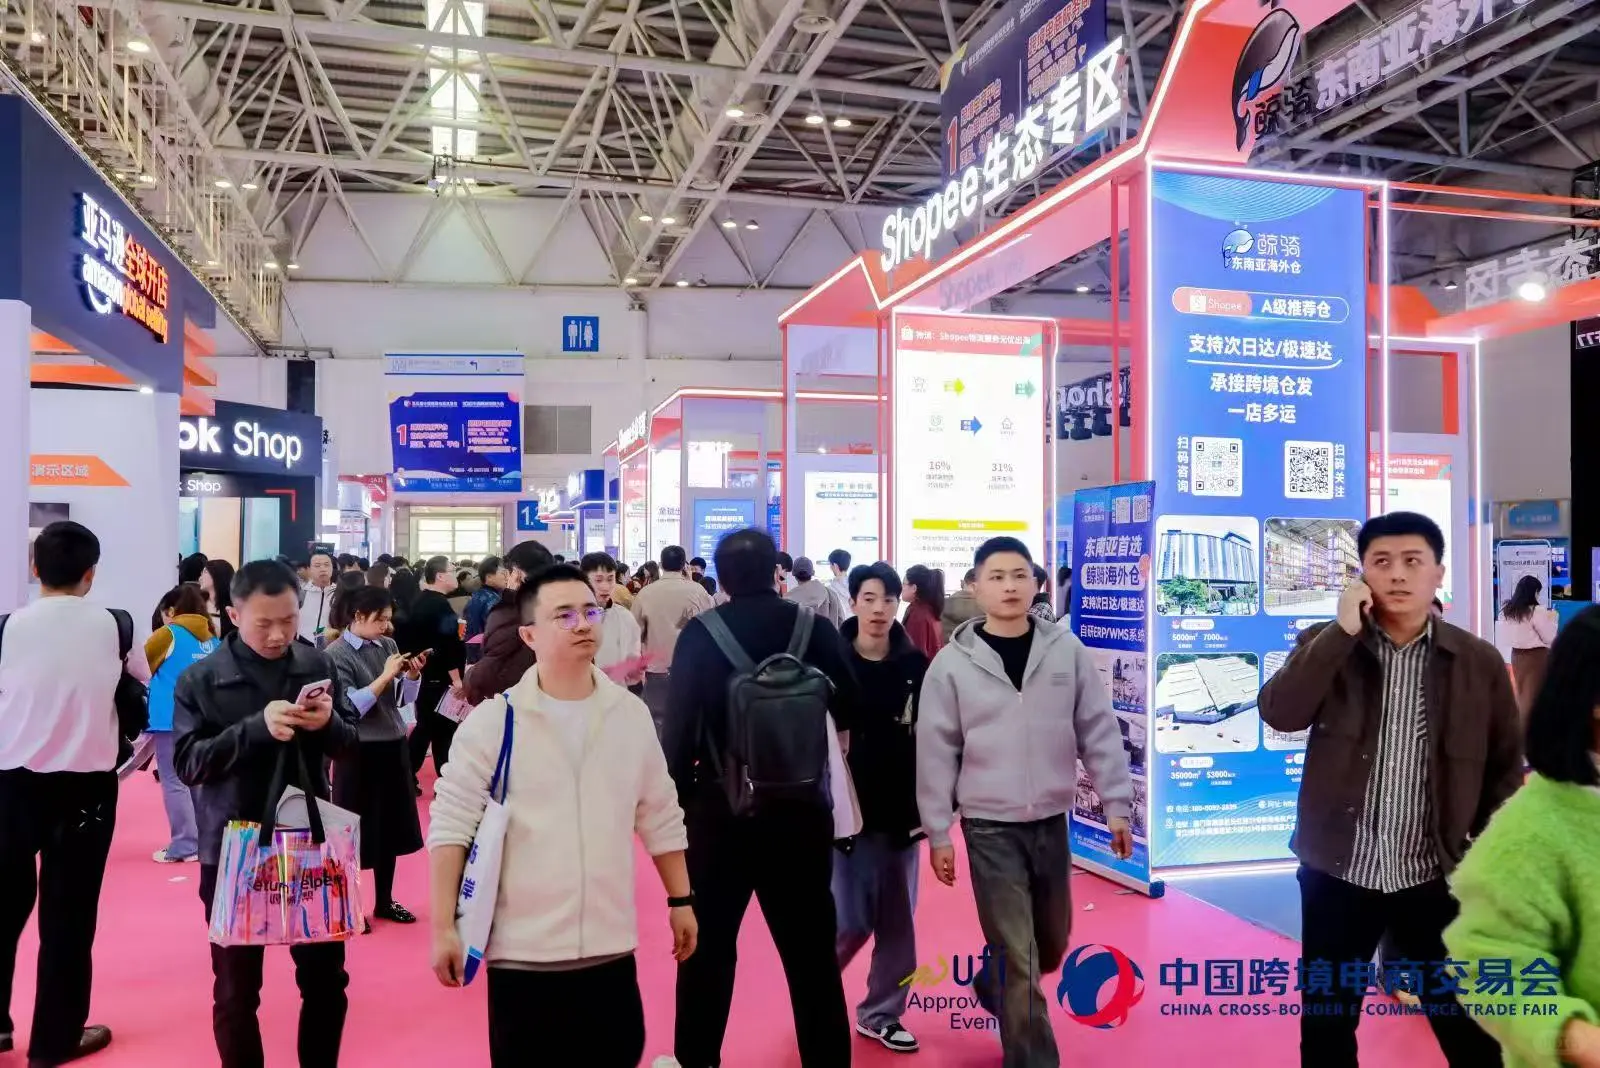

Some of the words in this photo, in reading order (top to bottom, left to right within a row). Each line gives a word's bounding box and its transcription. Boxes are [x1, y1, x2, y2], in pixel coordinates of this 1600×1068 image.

[82, 192, 169, 310] 亚马逊全球开店
[1257, 233, 1301, 257] 鲸骑
[1232, 256, 1301, 274] 东南亚海外仓
[83, 253, 124, 306] amazon
[1208, 297, 1242, 311] Shopee
[1261, 298, 1331, 319] A级推荐仓
[1188, 334, 1333, 361] 支持次日达/极速达
[1210, 373, 1313, 396] 承接跨境仓发
[1228, 403, 1297, 424] 一店多运
[233, 421, 302, 469] Shop
[929, 461, 951, 471] 16%
[991, 463, 1014, 473] 31%
[1177, 436, 1189, 493] 扫码咨询
[1335, 444, 1346, 498] 扫码关注
[187, 479, 222, 494] Shop
[1084, 536, 1143, 557] 东南亚首选
[1086, 564, 1140, 586] 鲸骑海外仓
[1081, 595, 1145, 612] 支持次日达/极速达
[1080, 623, 1146, 643] 自研ERP/WMS系统
